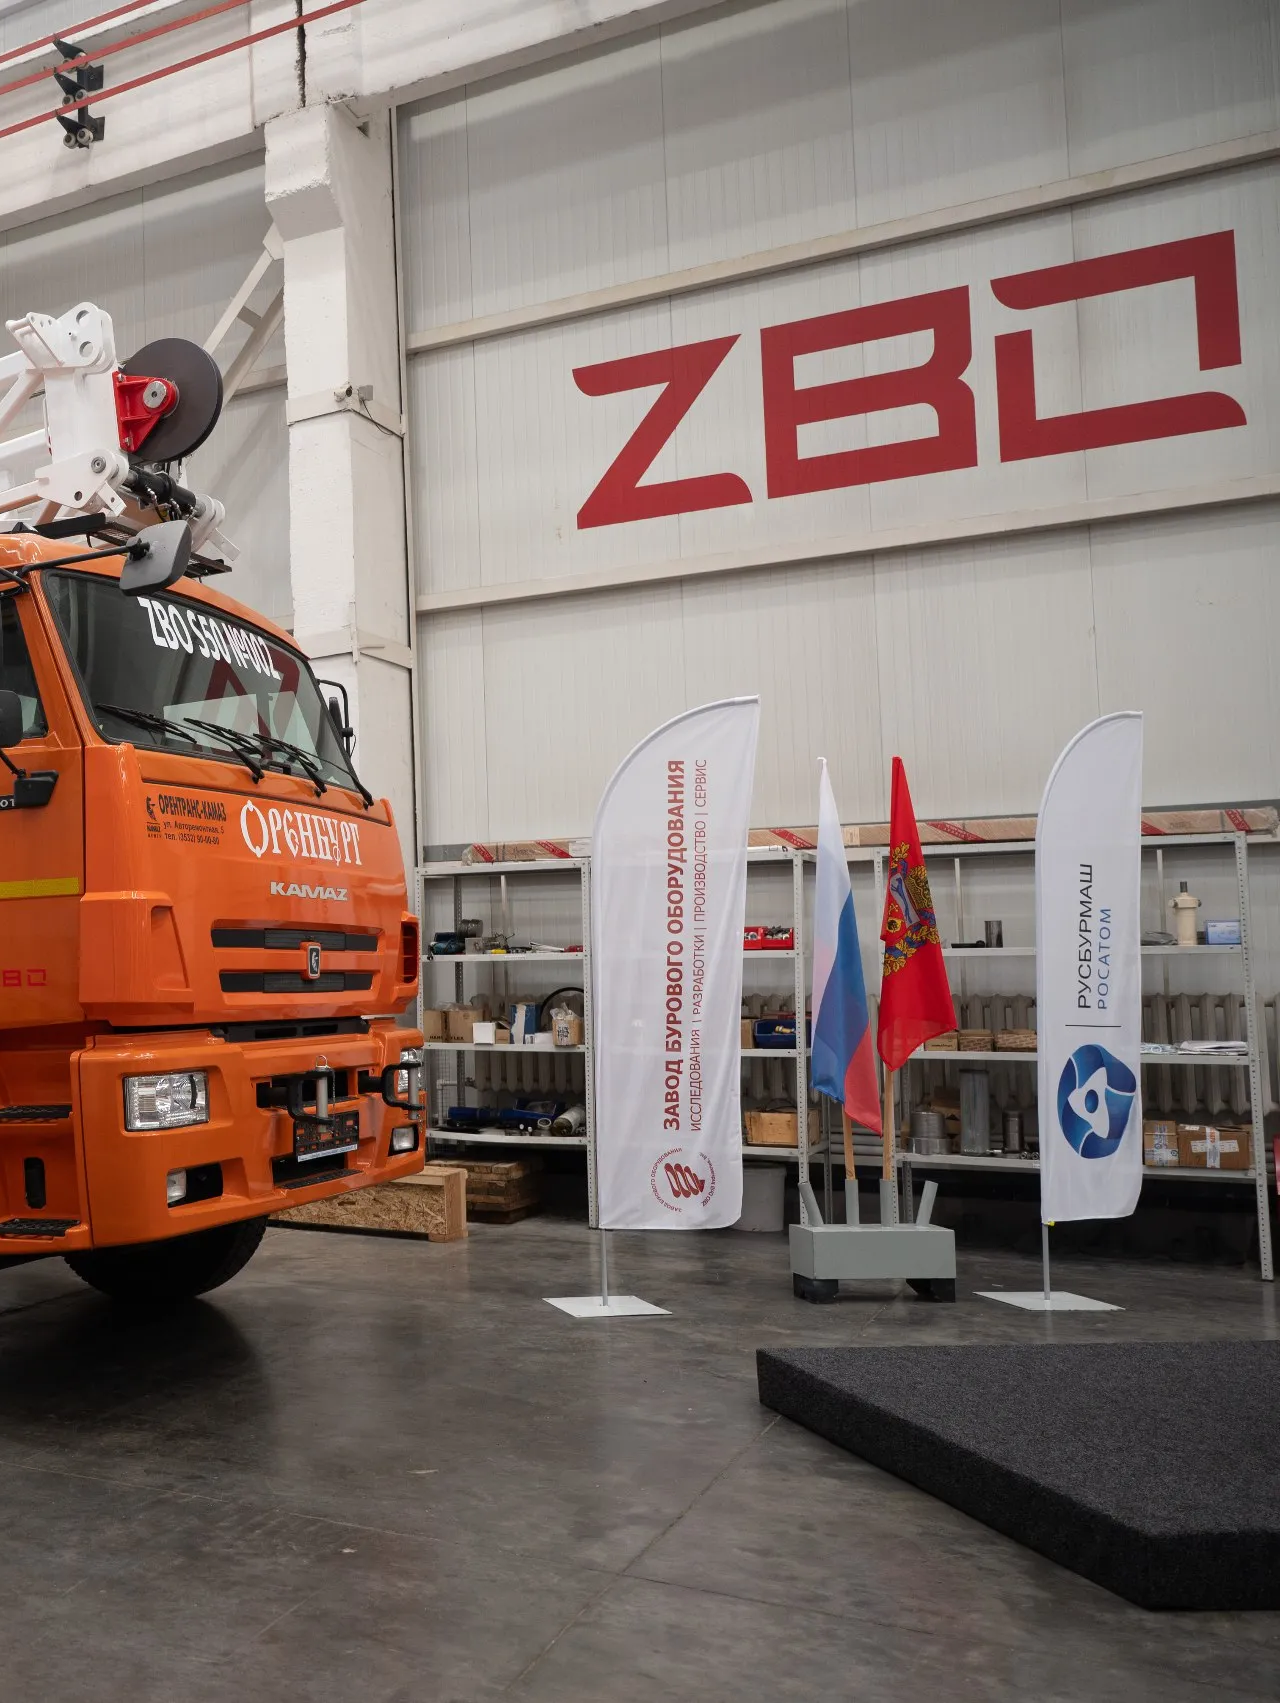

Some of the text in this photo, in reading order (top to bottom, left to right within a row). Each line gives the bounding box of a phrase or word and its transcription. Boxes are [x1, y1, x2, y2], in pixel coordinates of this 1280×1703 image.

[571, 229, 1248, 530] ZBO
[137, 596, 281, 681] ZBO S50 №002
[270, 881, 348, 901] KAMAZ
[663, 760, 687, 1131] ЗАВОД БУРОВОГО ОБОРУДОВАНИЯ
[690, 759, 708, 1132] ИССЛЕДОВАНИЯ РАЗРАБОТКИ ПРОИЗВОДСТВО СЕРВИС
[1077, 863, 1093, 1009] РУСБУРМАШ
[1097, 908, 1111, 1010] РОСАТОМ
